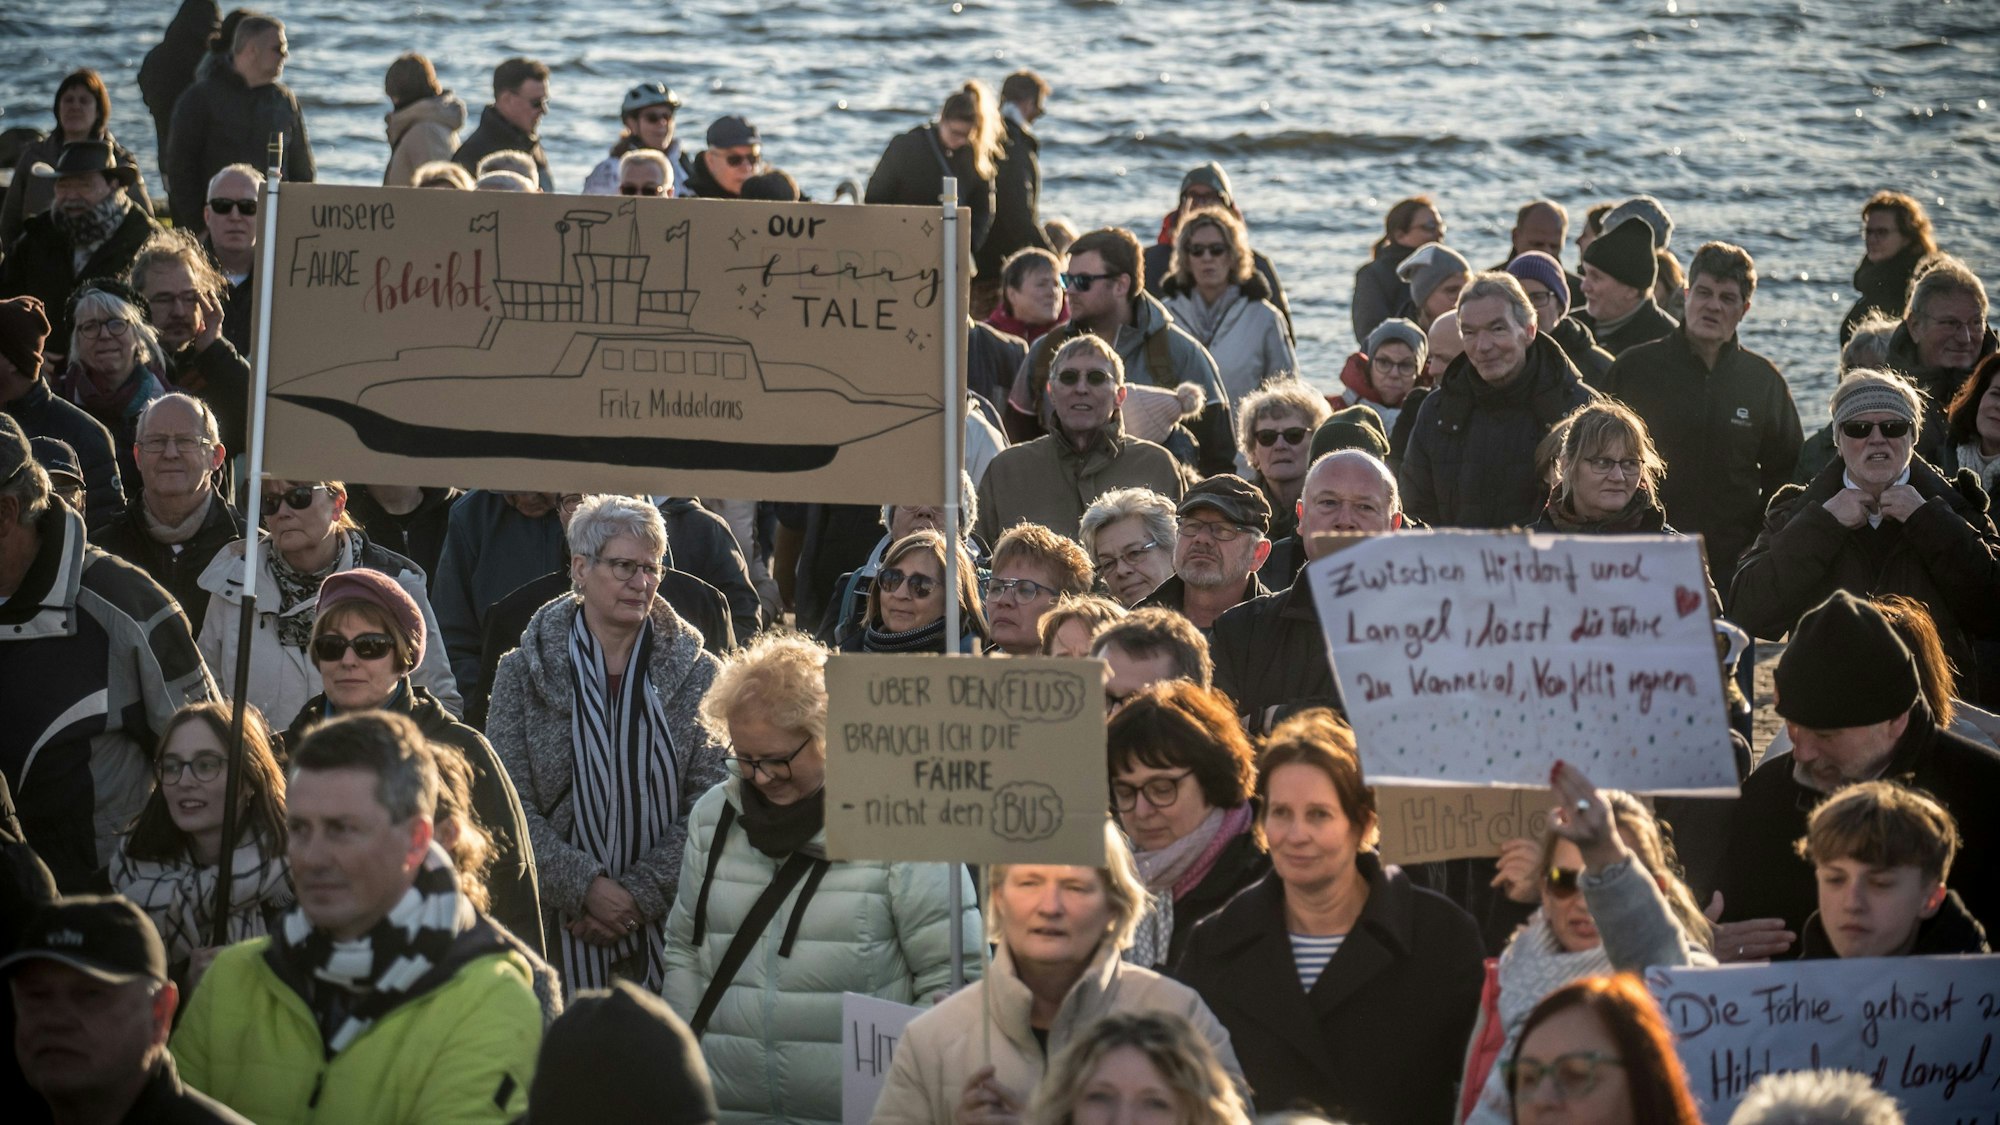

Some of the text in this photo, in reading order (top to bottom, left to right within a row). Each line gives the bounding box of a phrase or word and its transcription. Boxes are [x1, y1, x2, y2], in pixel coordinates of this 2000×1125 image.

[312, 203, 395, 231] unsere
[768, 214, 827, 239] our
[725, 254, 943, 308] ferry
[792, 295, 898, 330] TALE
[650, 388, 744, 421] Middelanis
[1327, 555, 1465, 598] Zwischen
[1590, 553, 1650, 583] und
[948, 675, 998, 709] DEN
[1004, 678, 1078, 715] FLUSS
[843, 722, 1022, 756] BRAUCH ICH DIE
[914, 756, 994, 791] FÄHRE
[865, 794, 928, 828] nicht
[940, 798, 984, 828] den
[1002, 792, 1055, 835] BUS
[1401, 788, 1550, 856] Hitdo
[1667, 994, 1750, 1040] Die
[1862, 982, 1964, 1049] gehört
[853, 1020, 899, 1077] HIT
